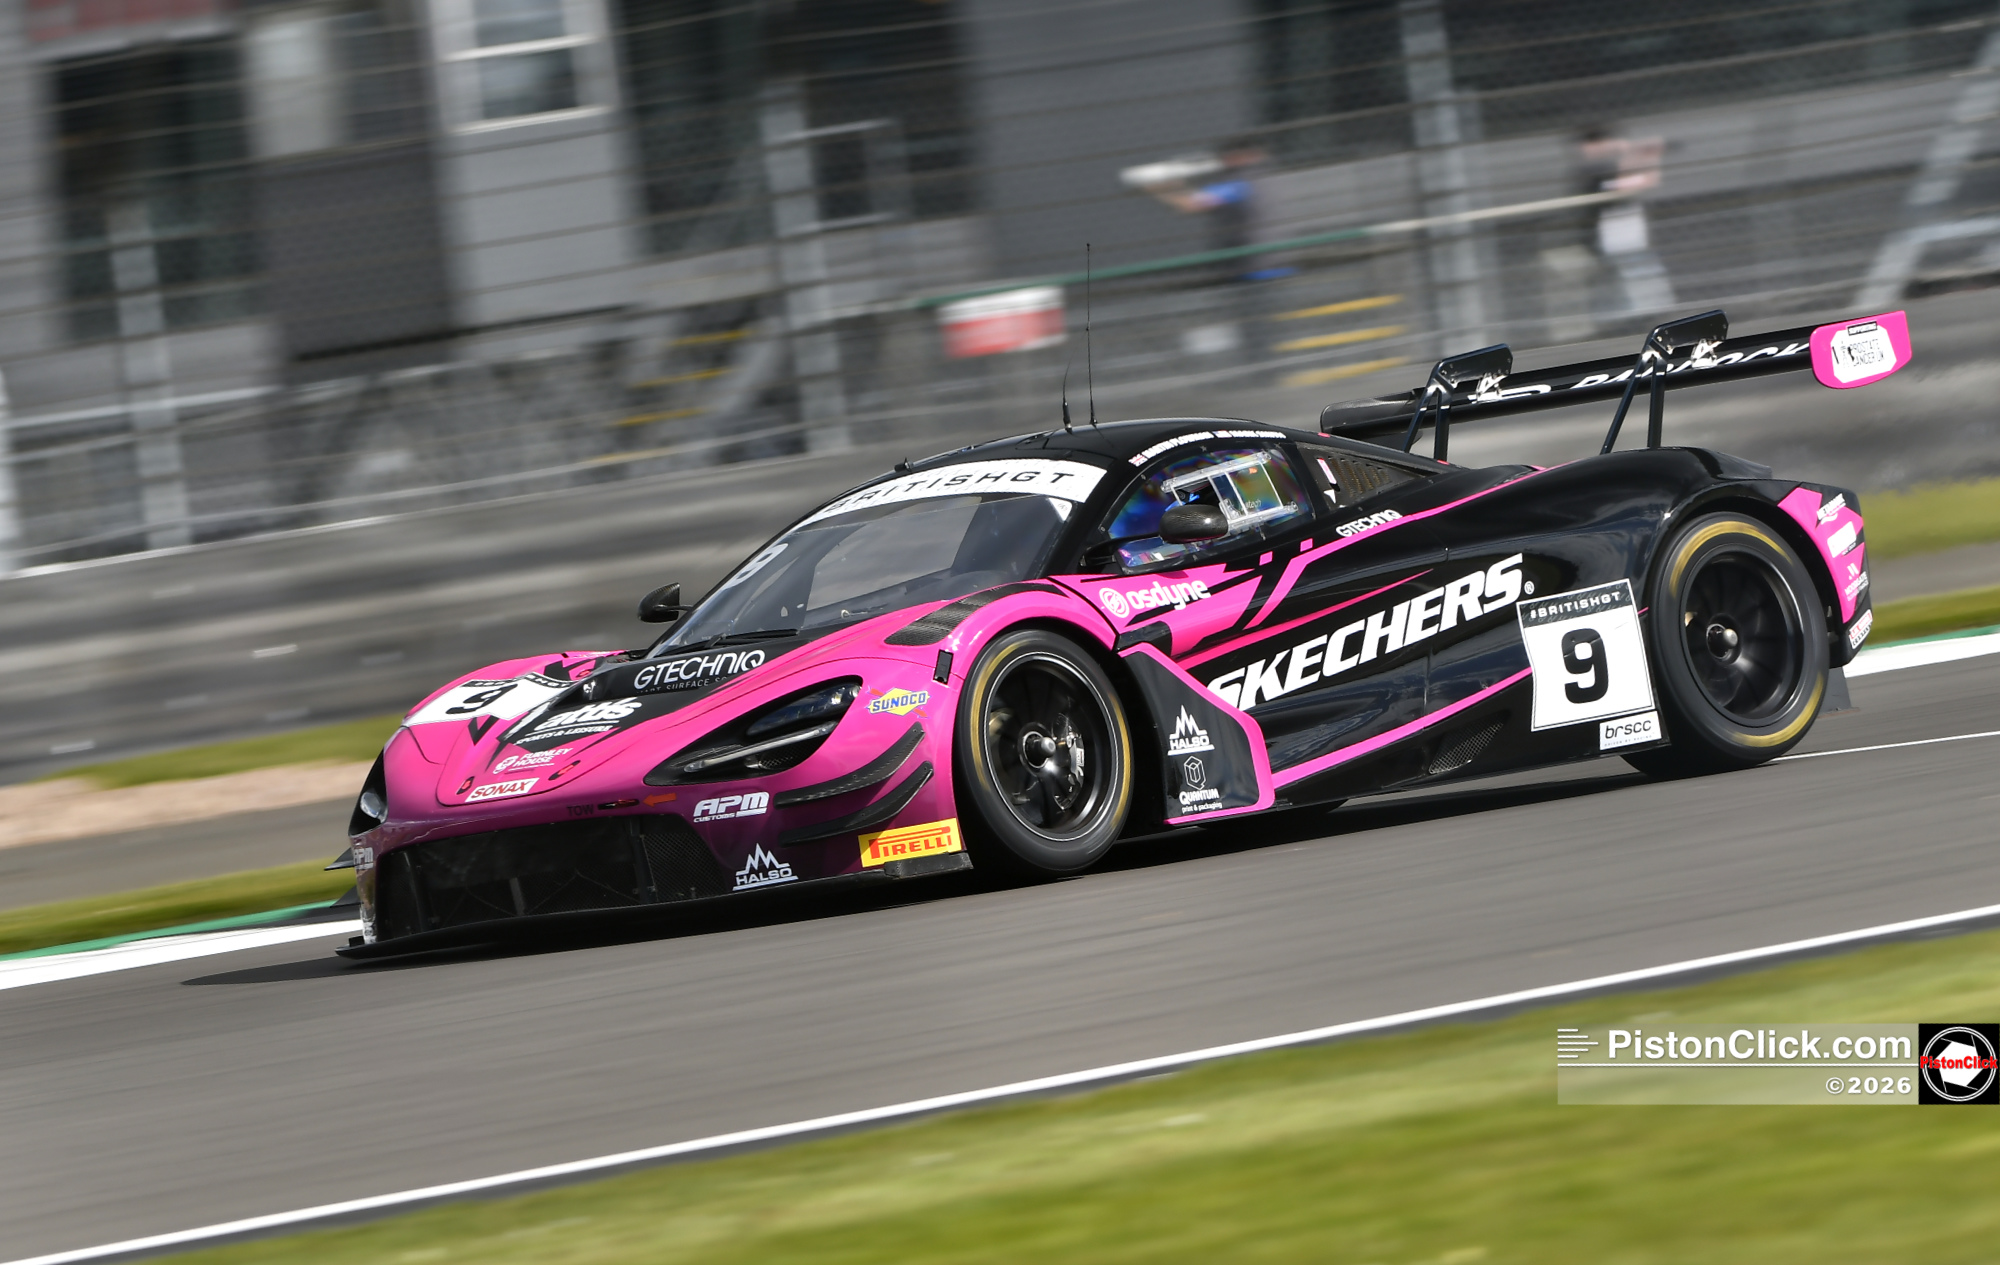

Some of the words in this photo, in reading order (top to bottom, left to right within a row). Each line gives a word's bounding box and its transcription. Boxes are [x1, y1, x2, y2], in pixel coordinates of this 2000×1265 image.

[1335, 509, 1403, 538] GTECHNIQ
[1128, 580, 1212, 610] osdyne
[1530, 591, 1621, 619] #BRITISHGT
[1205, 553, 1524, 712] SKECHERS
[634, 649, 766, 690] GTECHNIQ
[1561, 627, 1609, 705] 9
[445, 683, 518, 715] 9
[872, 692, 927, 712] SUNOCO
[1170, 735, 1210, 750] HALSO
[1605, 720, 1652, 739] brscc
[470, 781, 533, 799] SONAX
[1179, 788, 1220, 805] QUANTUM
[566, 803, 594, 817] TOW
[693, 791, 770, 817] APM
[693, 813, 735, 823] CUSTOMS
[869, 826, 952, 859] PIRELLI
[736, 867, 793, 886] HALSO
